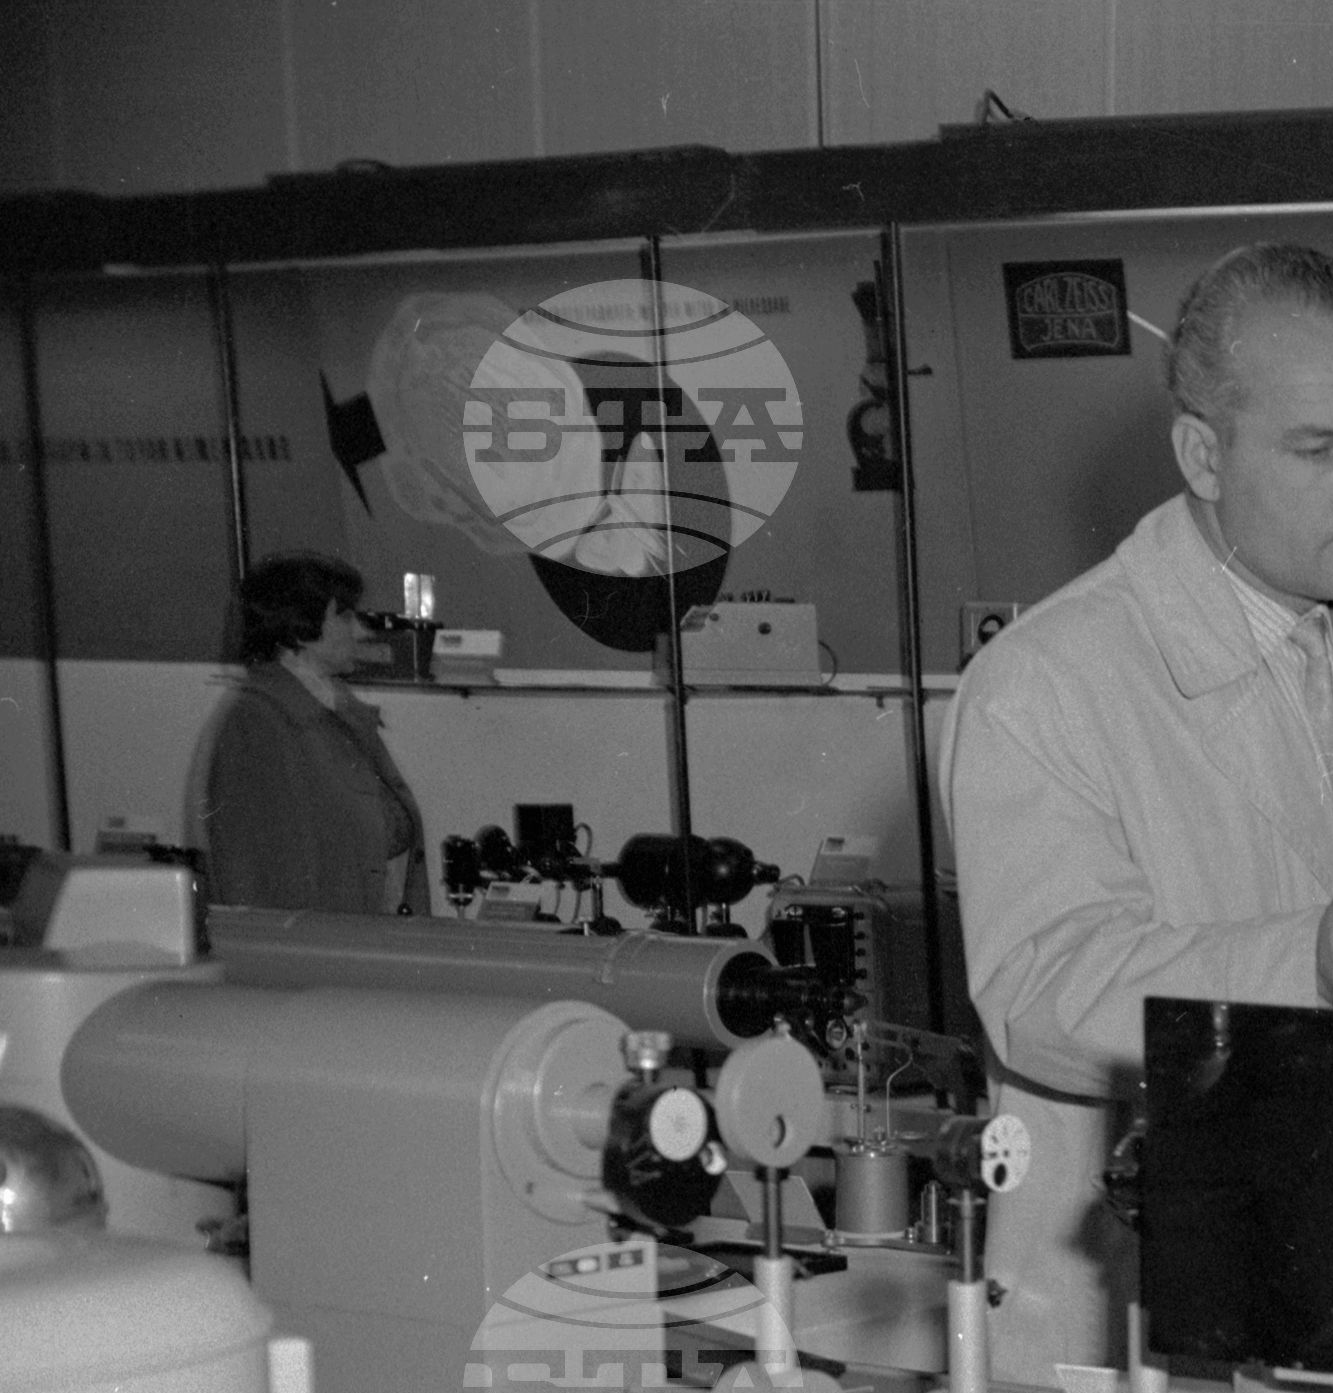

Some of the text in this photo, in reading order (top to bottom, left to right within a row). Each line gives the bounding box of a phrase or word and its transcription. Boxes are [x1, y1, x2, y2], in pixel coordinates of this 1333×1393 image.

[1022, 276, 1109, 313] CARL ZEISS
[1040, 318, 1097, 341] JENA
